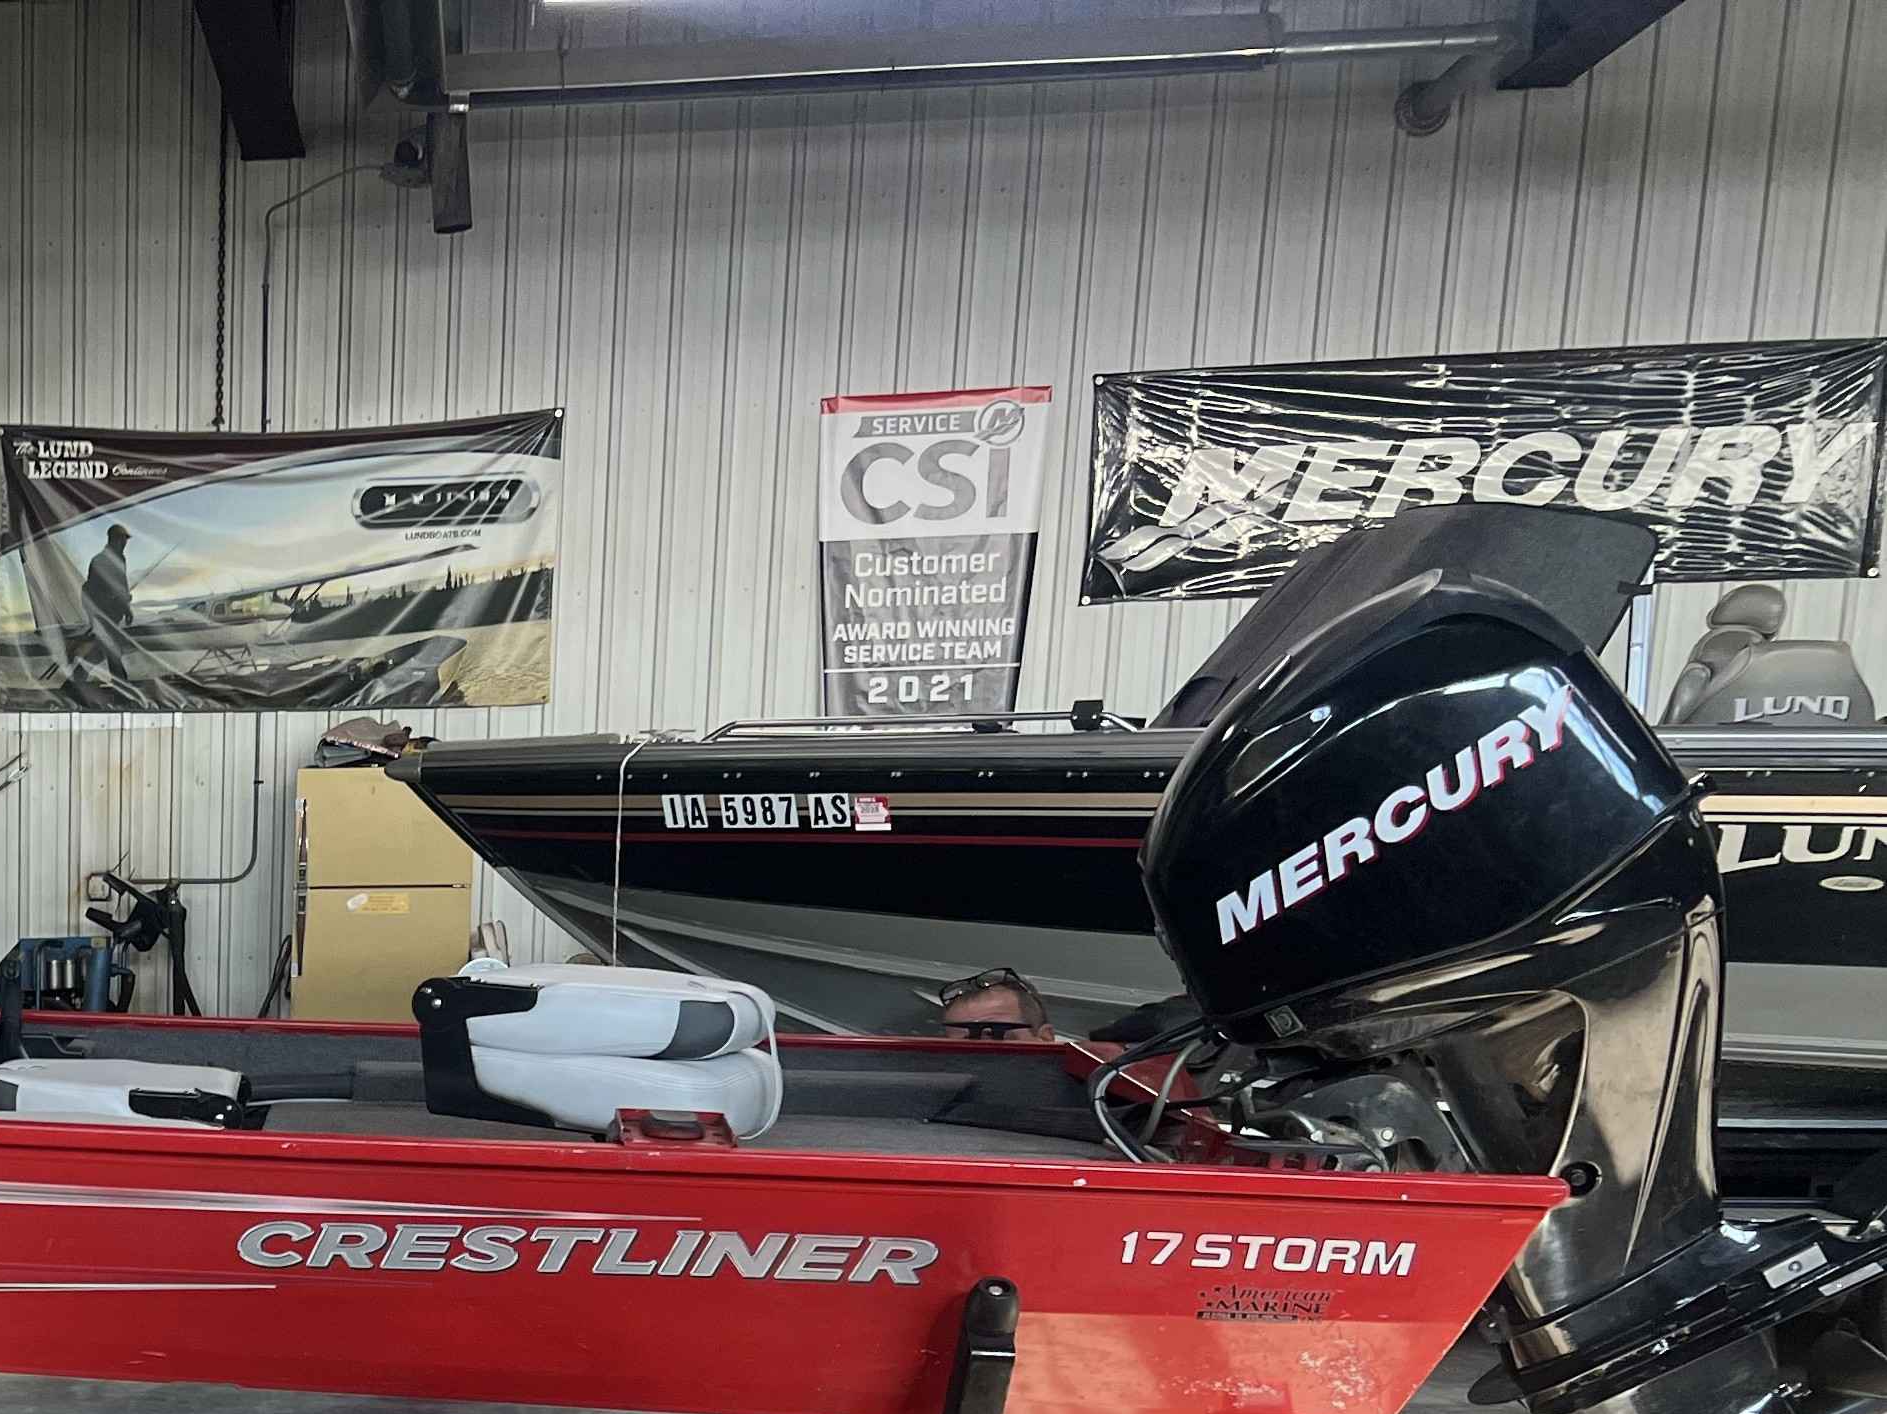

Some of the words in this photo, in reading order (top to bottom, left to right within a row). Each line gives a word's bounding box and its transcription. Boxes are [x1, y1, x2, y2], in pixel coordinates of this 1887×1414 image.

[872, 414, 961, 435] SERVICE
[38, 440, 94, 458] LUND
[28, 460, 108, 480] LEGEND
[1159, 421, 1878, 526] MERCURY
[854, 551, 1000, 578] Customer
[845, 576, 1007, 609] Nominated
[832, 620, 911, 641] AWARD
[917, 617, 1016, 638] WINNING
[844, 643, 935, 664] SERVICE
[941, 640, 1002, 660] TEAM
[868, 673, 974, 704] 2021
[1734, 695, 1851, 722] LUND
[668, 796, 706, 826] IA
[723, 796, 793, 826] 5987
[813, 794, 846, 826] AS
[1215, 684, 1574, 946] MERCURY
[235, 1220, 940, 1285] CRESTLINER
[1121, 1231, 1183, 1265] 17
[1190, 1233, 1416, 1277] STORM
[1224, 1283, 1333, 1301] American
[1216, 1300, 1324, 1314] MARINE
